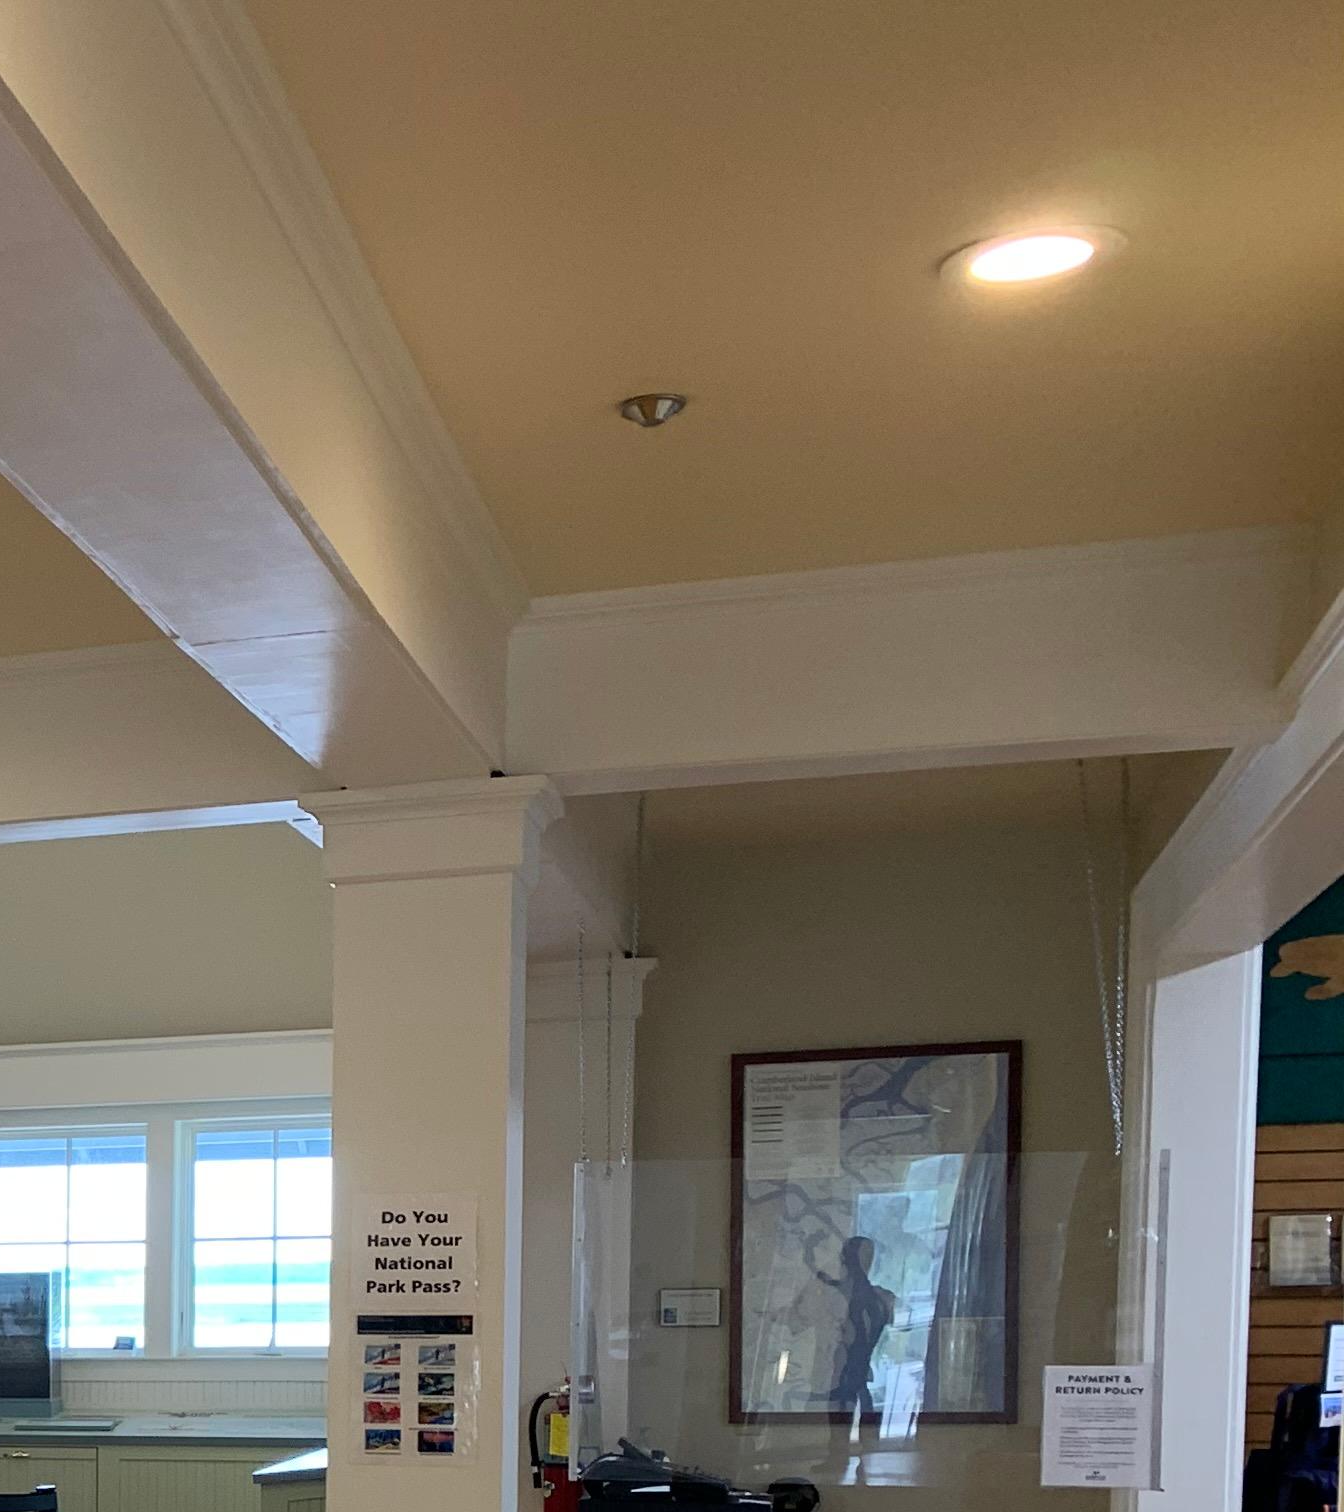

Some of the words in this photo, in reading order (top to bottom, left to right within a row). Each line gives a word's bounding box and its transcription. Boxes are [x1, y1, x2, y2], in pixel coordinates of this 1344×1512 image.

[381, 1211, 406, 1224] Do
[412, 1210, 449, 1223] You
[367, 1234, 412, 1247] Have
[418, 1233, 463, 1246] Your
[375, 1256, 453, 1270] National
[366, 1280, 406, 1293] Park
[412, 1280, 461, 1293] Pass?
[1068, 1375, 1120, 1383] PAYMENT
[1124, 1375, 1132, 1383] &
[1055, 1386, 1101, 1394] RETURN
[1104, 1386, 1144, 1395] POLICY
